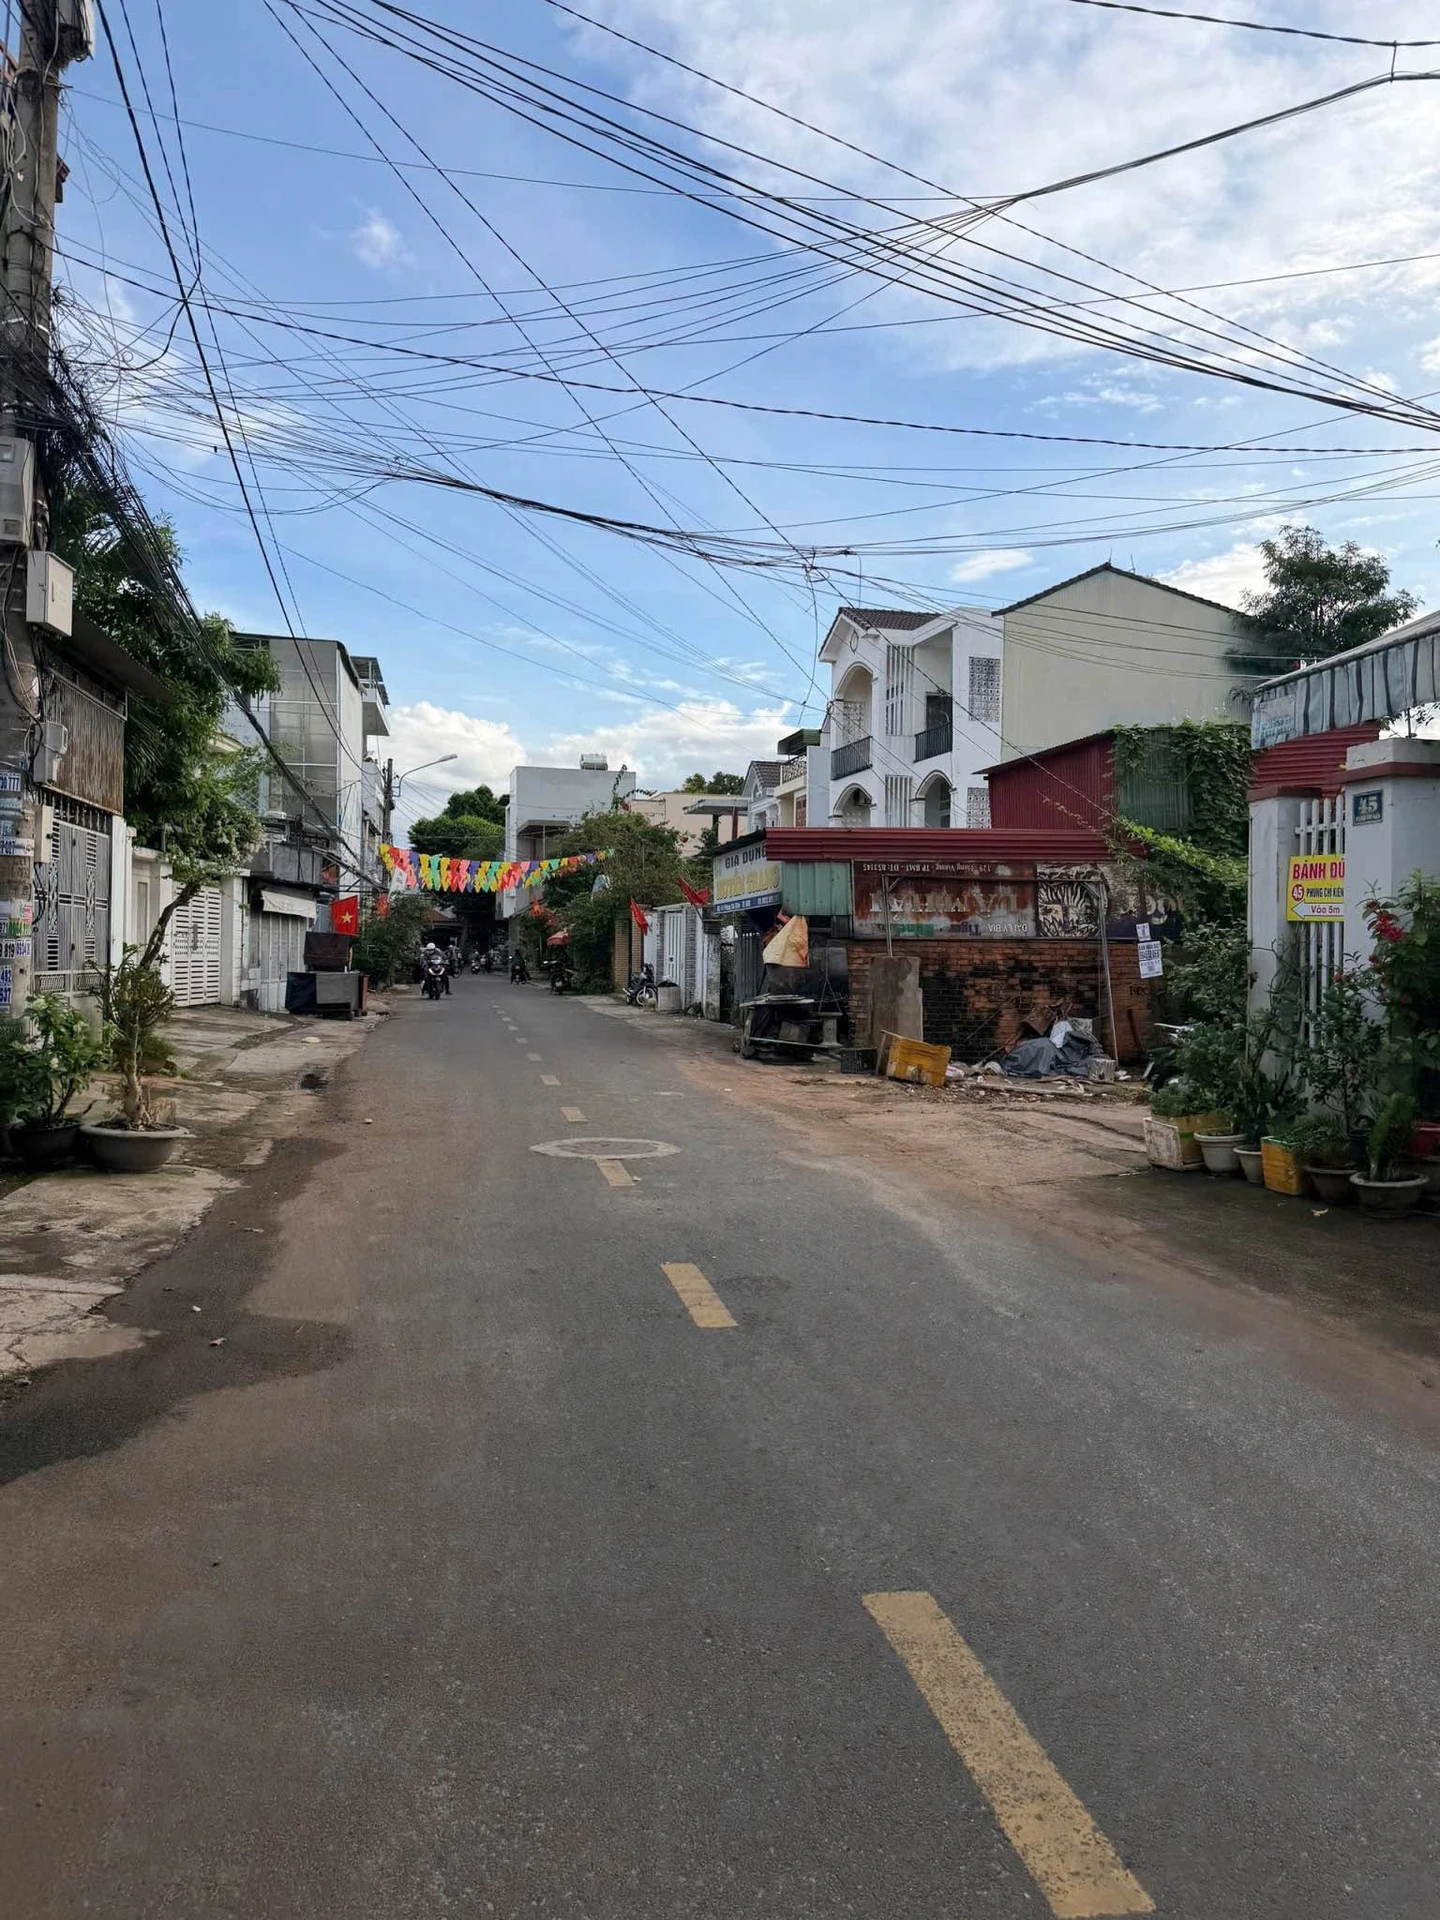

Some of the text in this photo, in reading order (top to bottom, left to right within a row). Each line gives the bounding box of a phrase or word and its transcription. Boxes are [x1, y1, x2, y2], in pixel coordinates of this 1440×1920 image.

[1357, 796, 1378, 814] 45
[725, 854, 740, 869] GIA
[1292, 859, 1326, 880] BÁNH
[1293, 886, 1304, 898] 45
[1328, 905, 1341, 914] 5m
